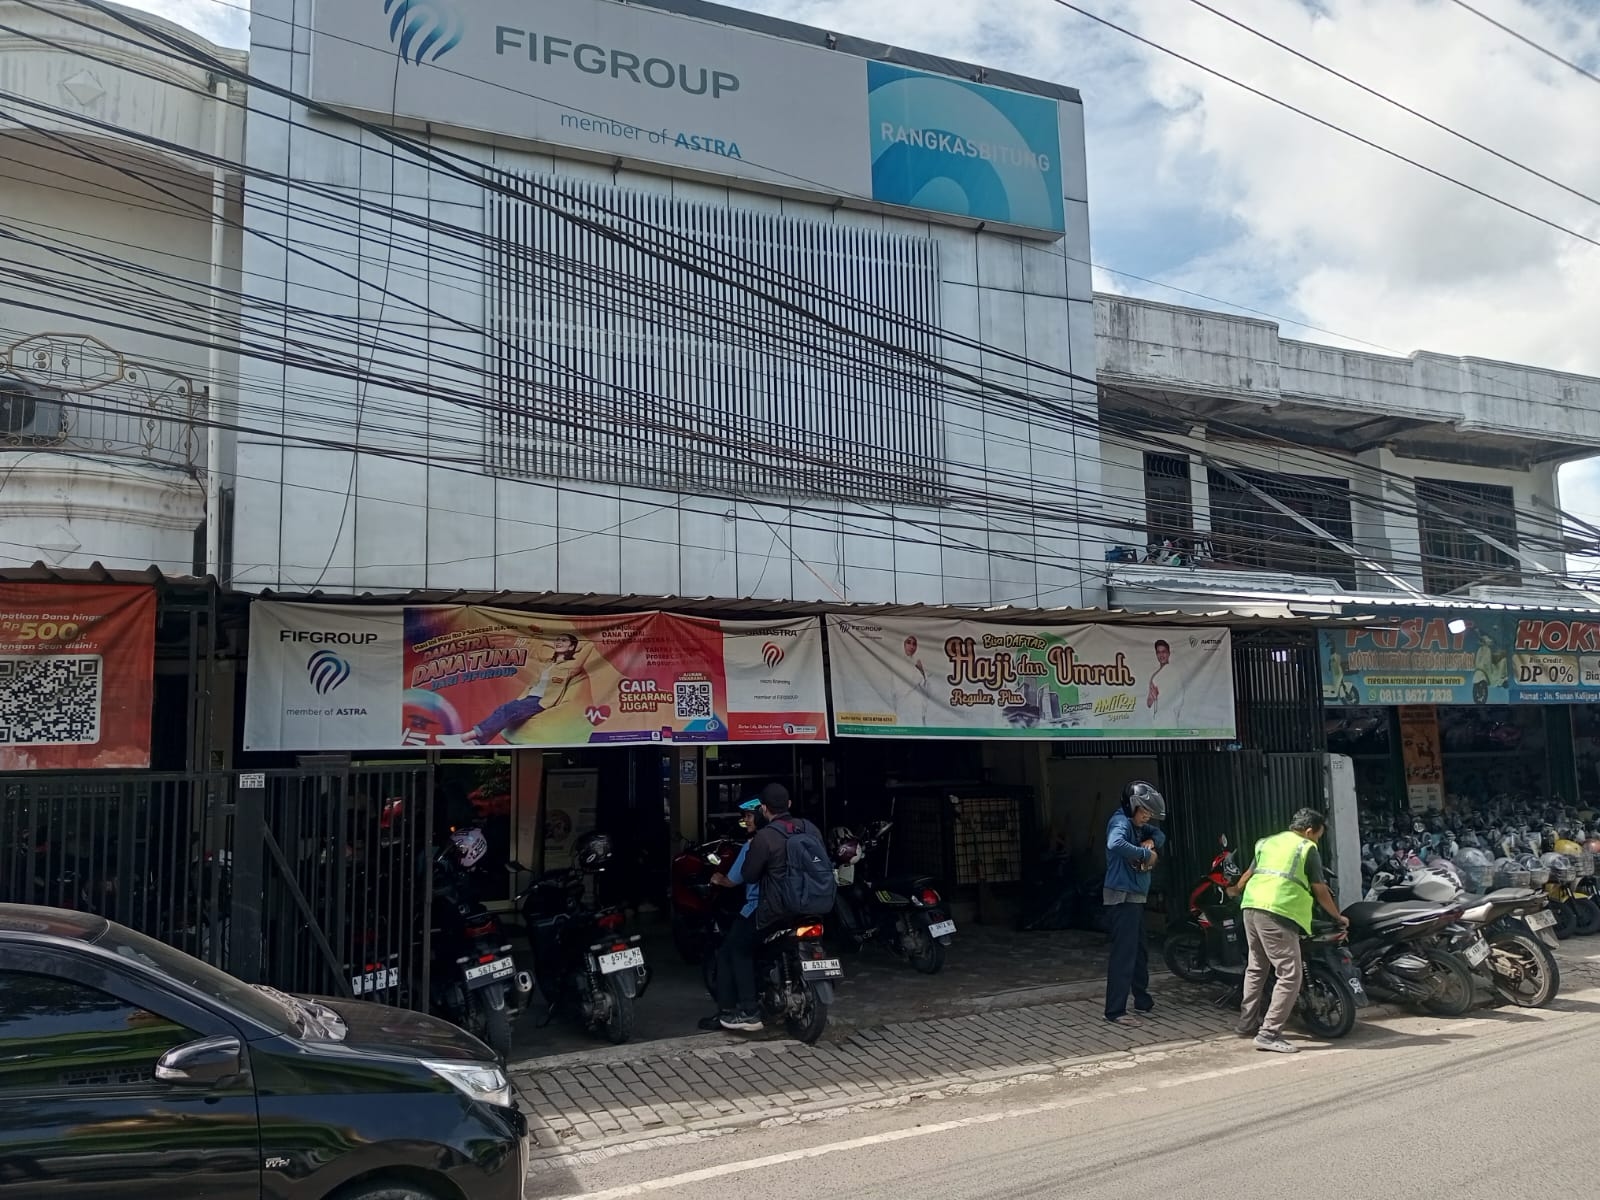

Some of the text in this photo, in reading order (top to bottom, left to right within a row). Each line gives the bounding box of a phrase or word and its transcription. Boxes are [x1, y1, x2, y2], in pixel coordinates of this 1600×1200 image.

[495, 25, 740, 100] FIFGROUP
[560, 114, 743, 159] member of ASTRA
[880, 121, 1051, 173] RANGKASBITUNG
[41, 613, 70, 621] Dana
[2, 621, 20, 632] Rp
[17, 622, 79, 640] 500
[279, 630, 378, 645] FIFGROUP
[64, 642, 92, 650] disini
[982, 634, 1047, 651] Bisa DAFTAR
[411, 648, 528, 688] DANA TUNAI
[944, 636, 1135, 690] Haji dan Umrah
[1519, 665, 1574, 683] DP 0%
[620, 680, 656, 693] CAIR
[620, 692, 673, 702] SEKARANG
[997, 689, 1026, 706] Plus
[1379, 689, 1404, 703] 0813
[1555, 691, 1574, 700] Sunan
[286, 707, 368, 717] member of ASTRA
